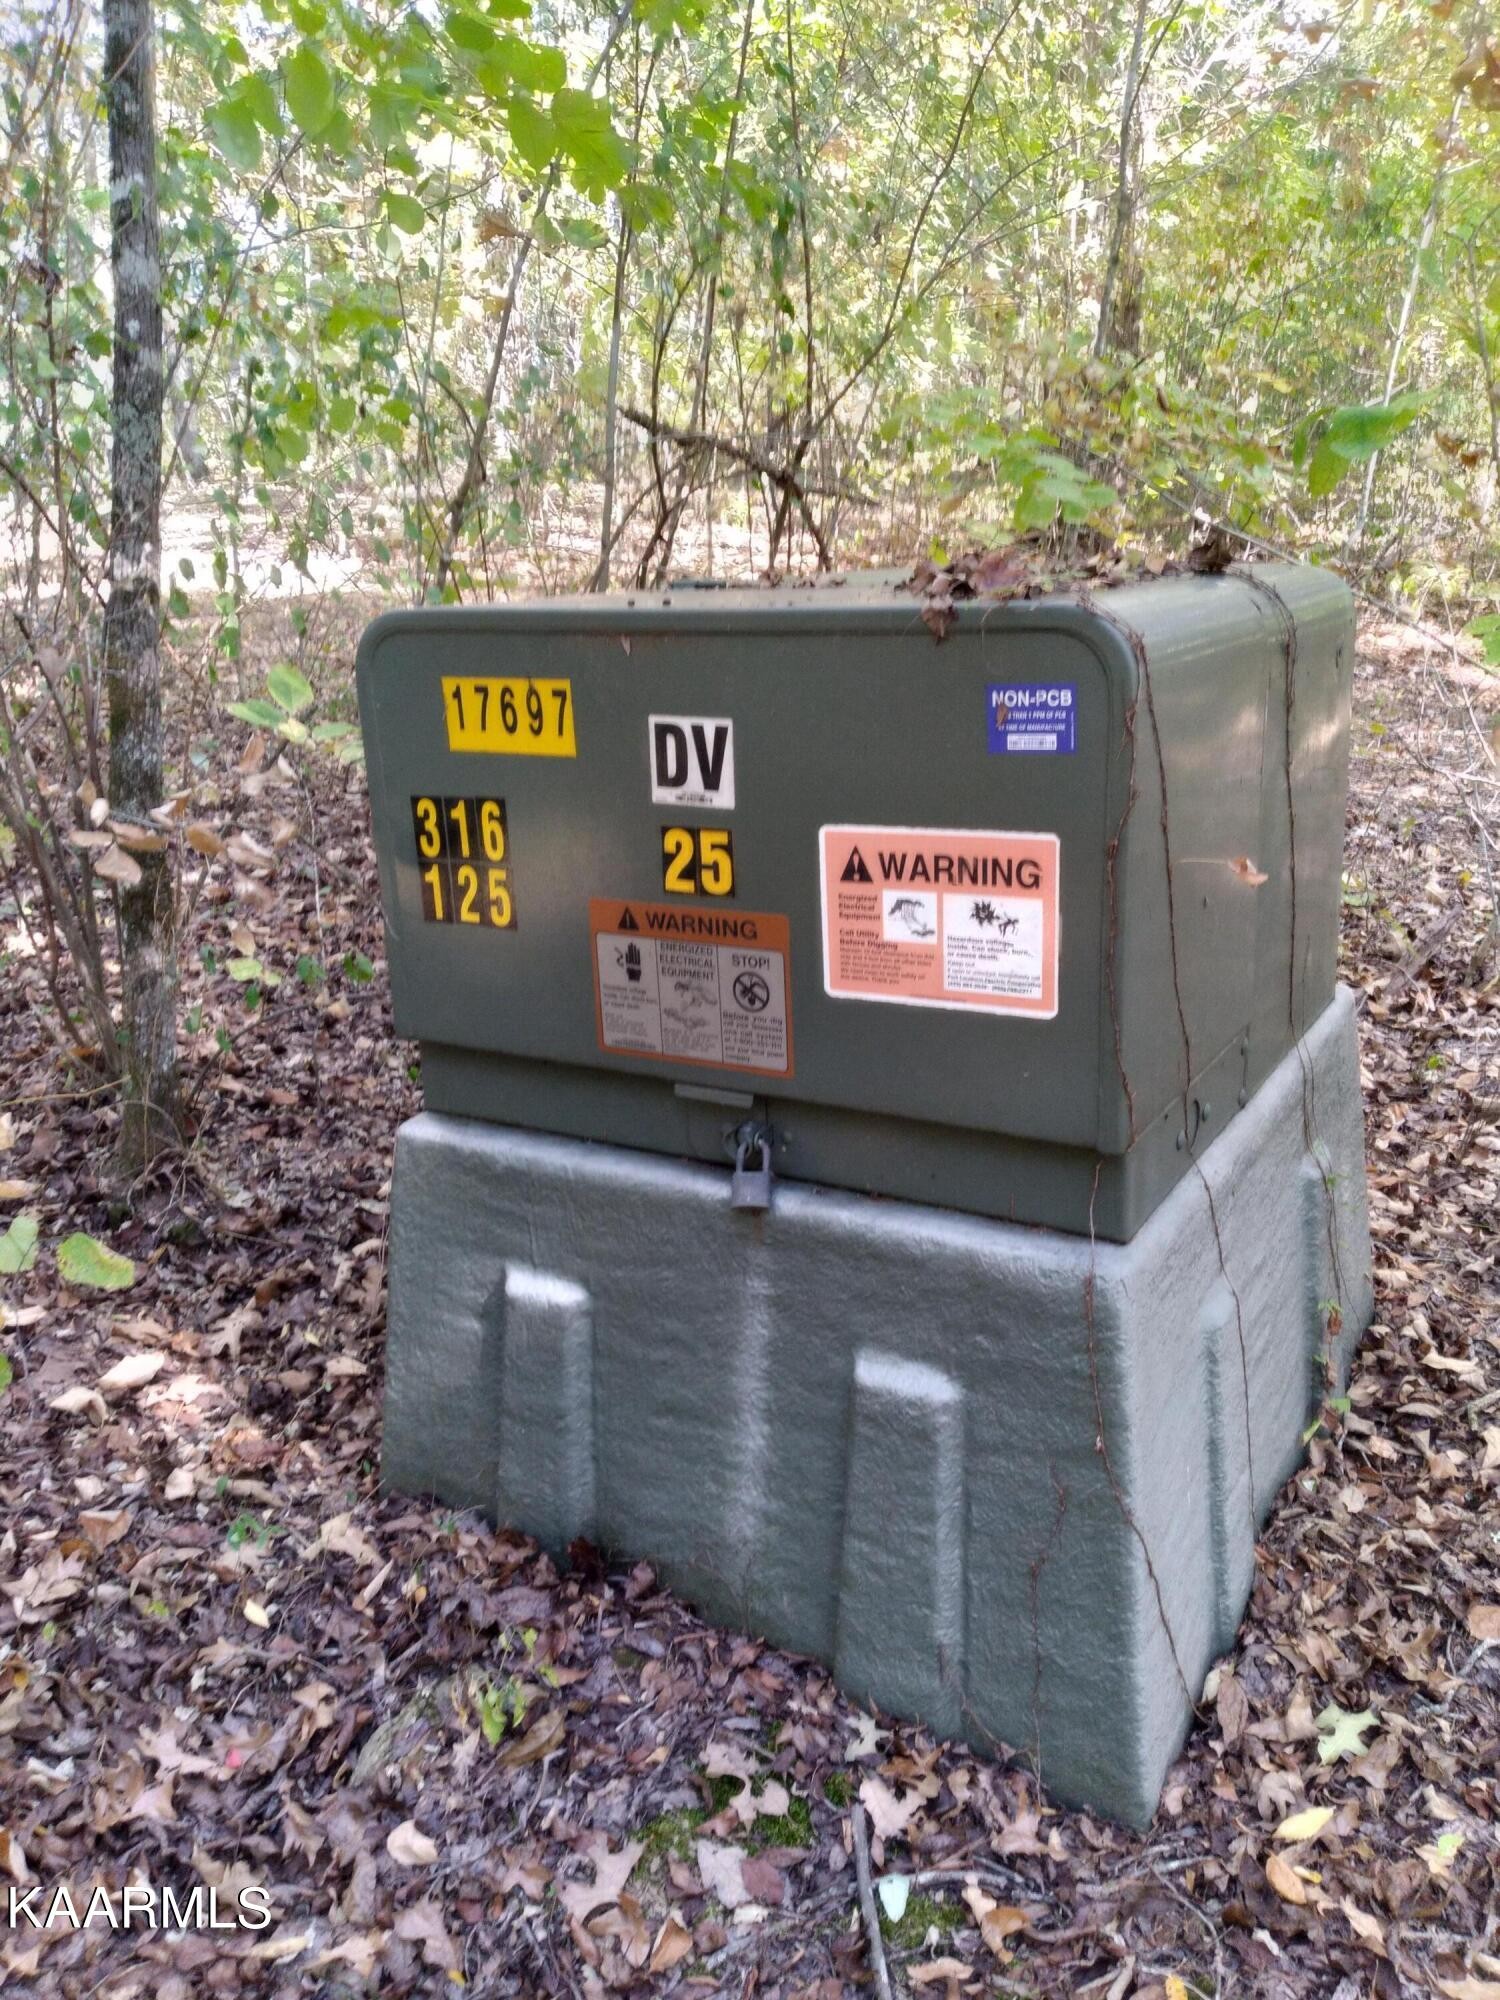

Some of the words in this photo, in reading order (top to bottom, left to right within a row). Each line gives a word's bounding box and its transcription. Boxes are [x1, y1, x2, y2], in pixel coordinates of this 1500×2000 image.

[452, 685, 568, 737] 17697
[992, 689, 1072, 707] NON-PCB
[654, 722, 728, 791] DV
[416, 797, 505, 862] 316
[664, 828, 733, 896] 25
[878, 851, 1043, 890] WARNING
[424, 865, 512, 928] 125
[645, 911, 758, 940] WARNING
[838, 912, 880, 922] Equipment
[659, 953, 713, 968] ELECTRICAL
[660, 943, 713, 955] ENERGIZED
[732, 954, 770, 970] STOP!
[661, 966, 714, 981] EQUIPMENT
